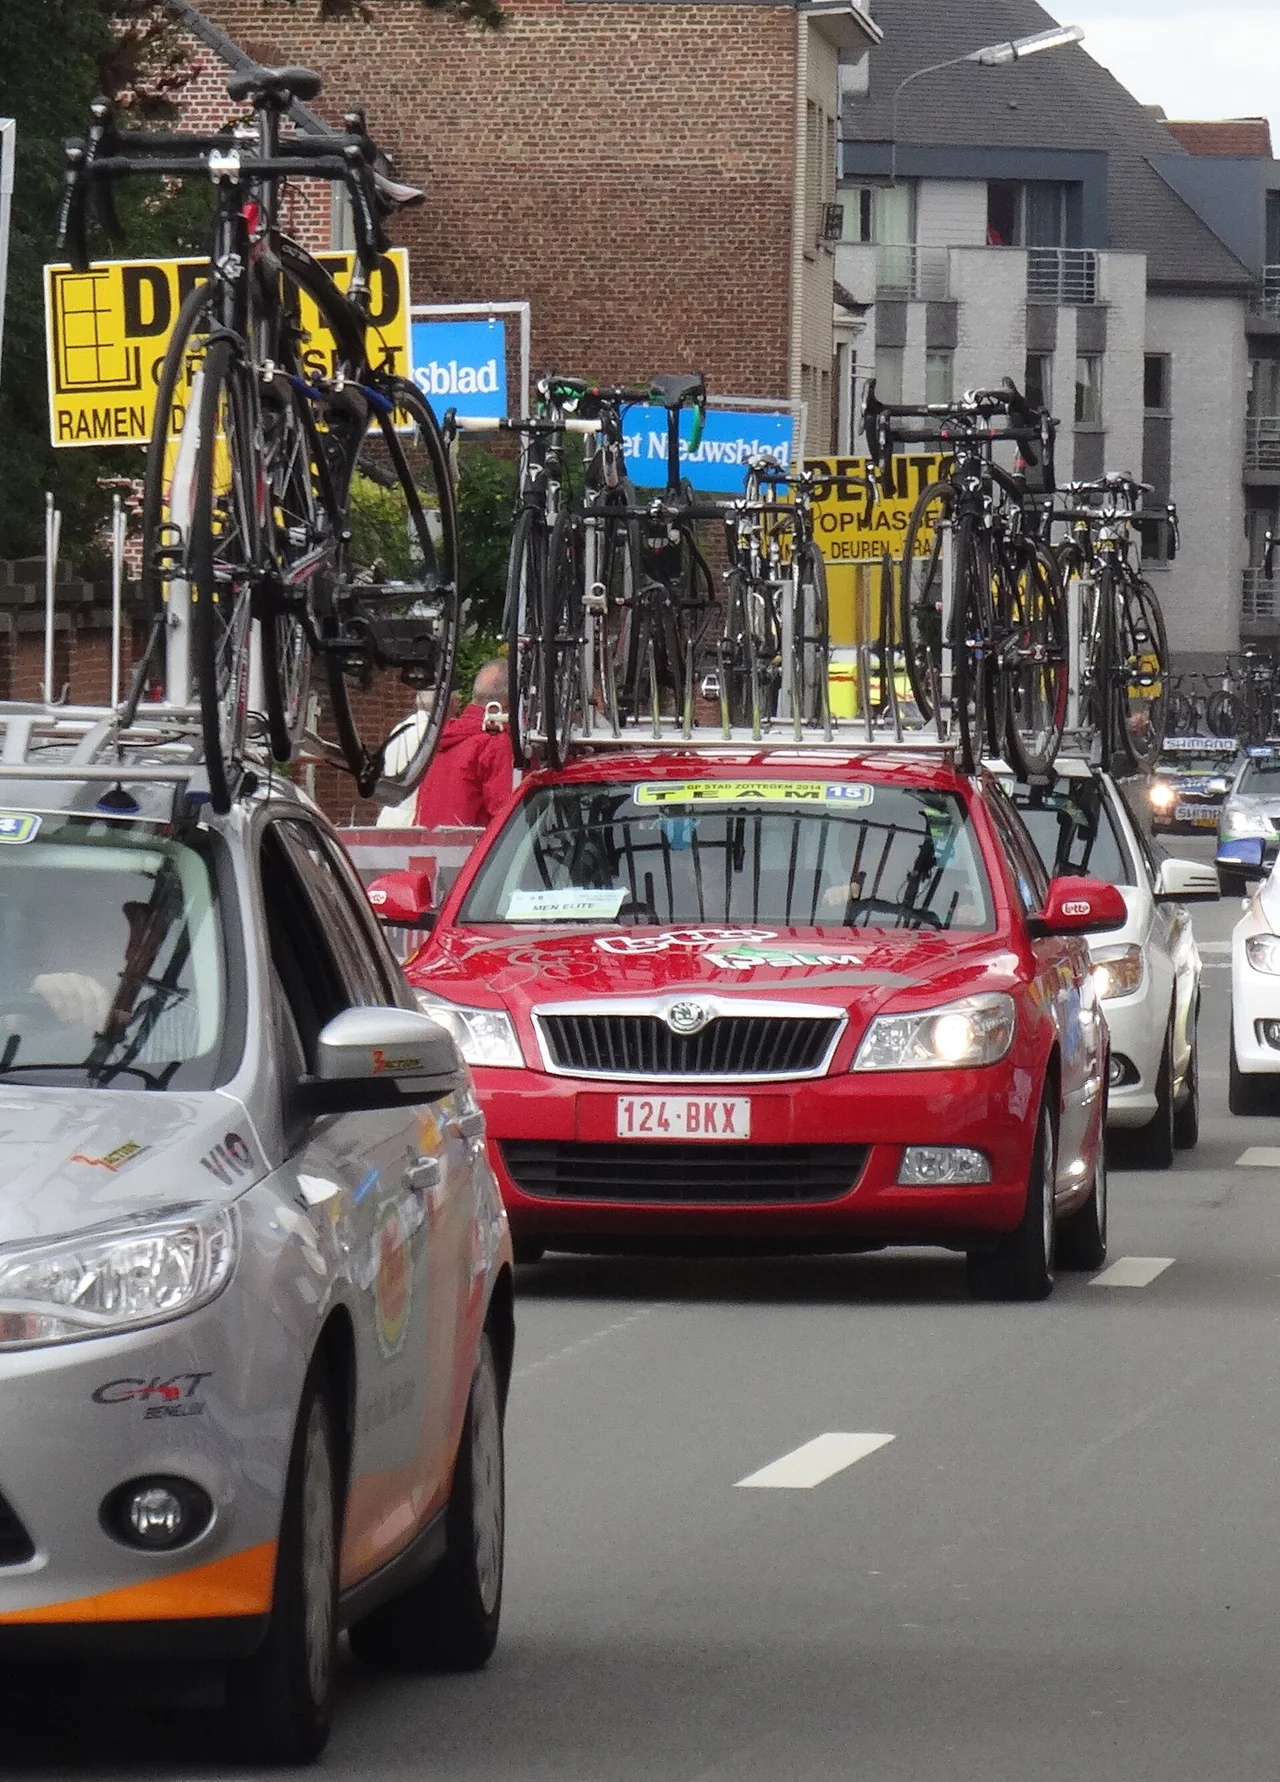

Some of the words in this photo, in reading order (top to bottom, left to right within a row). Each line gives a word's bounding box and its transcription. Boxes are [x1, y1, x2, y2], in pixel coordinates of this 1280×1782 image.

[412, 358, 499, 395] sblad
[58, 408, 146, 440] RAMEN
[647, 431, 790, 466] Neuwsblad
[831, 541, 891, 559] DEUREN
[1166, 739, 1234, 749] SHIMANO
[647, 790, 820, 800] TEAM
[828, 786, 862, 798] 15
[623, 1101, 737, 1133] 124-BKX
